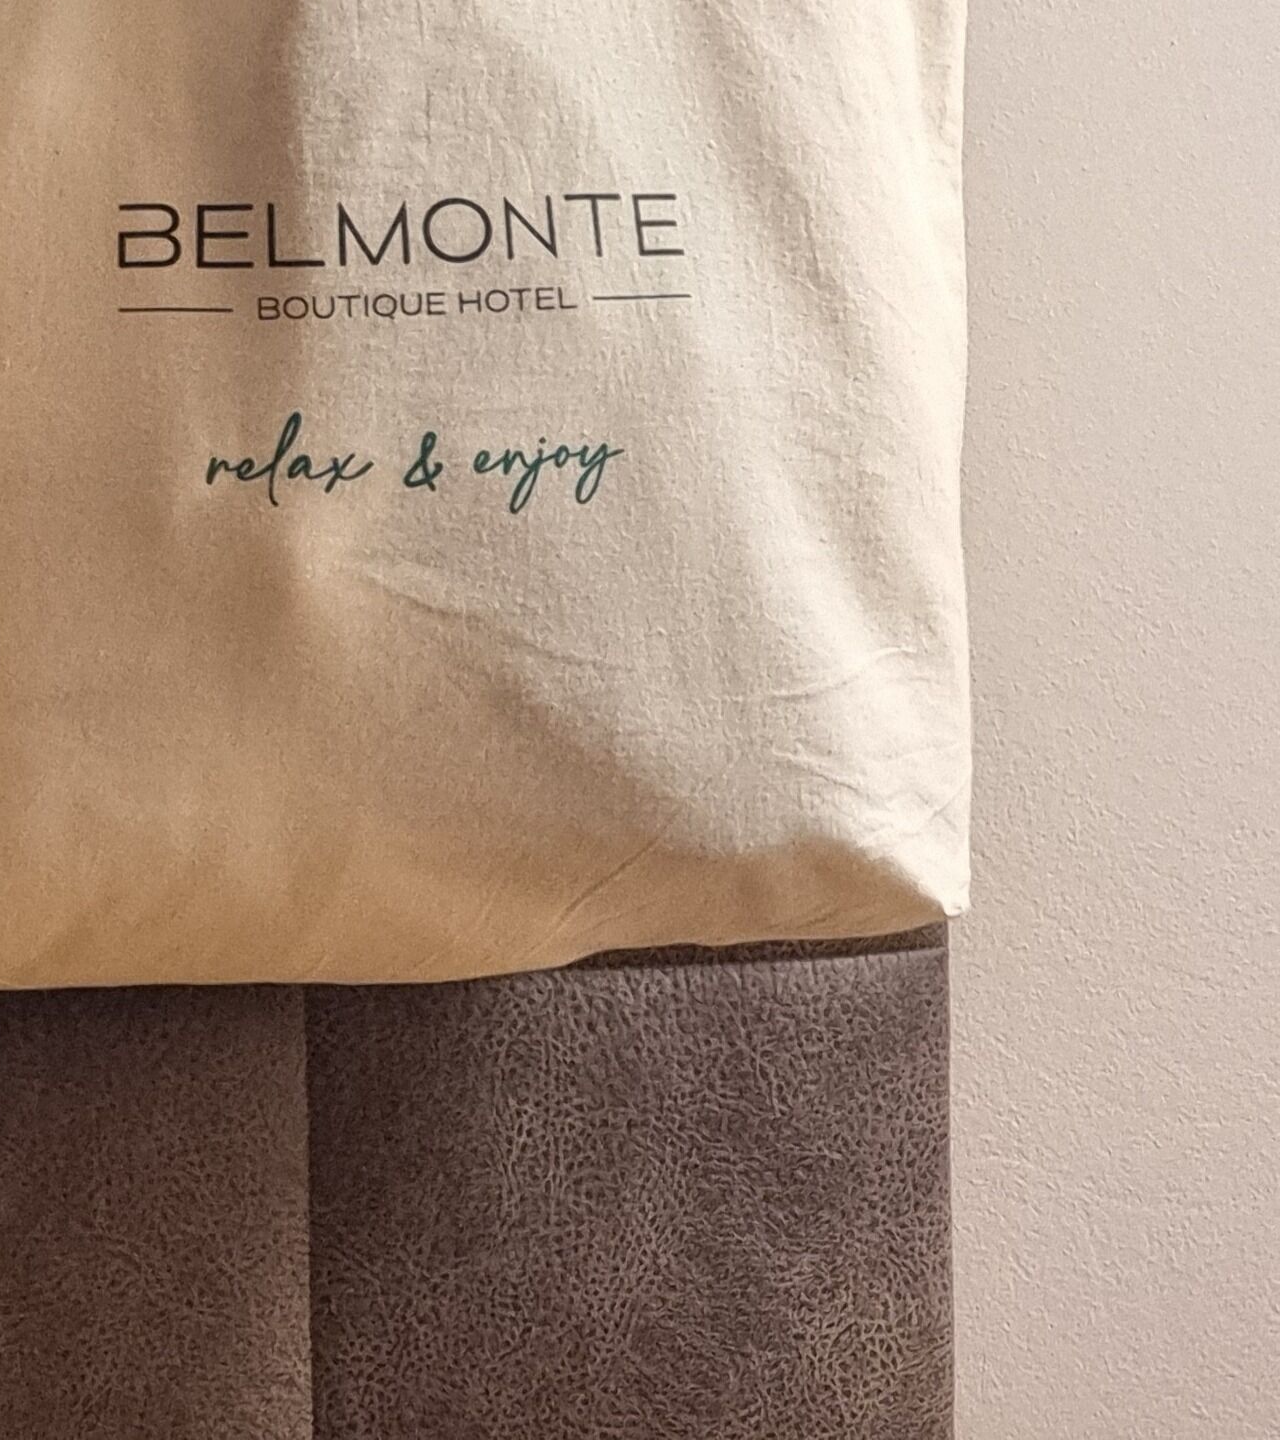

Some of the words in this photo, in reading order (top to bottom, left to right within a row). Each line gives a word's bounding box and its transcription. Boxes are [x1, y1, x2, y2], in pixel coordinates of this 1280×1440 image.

[116, 192, 686, 270] BELMONTE
[257, 291, 447, 322] BOUTIQUE
[459, 286, 578, 316] HOTEL
[205, 411, 376, 507] relax
[403, 430, 444, 492] &
[472, 436, 626, 515] enjoy
